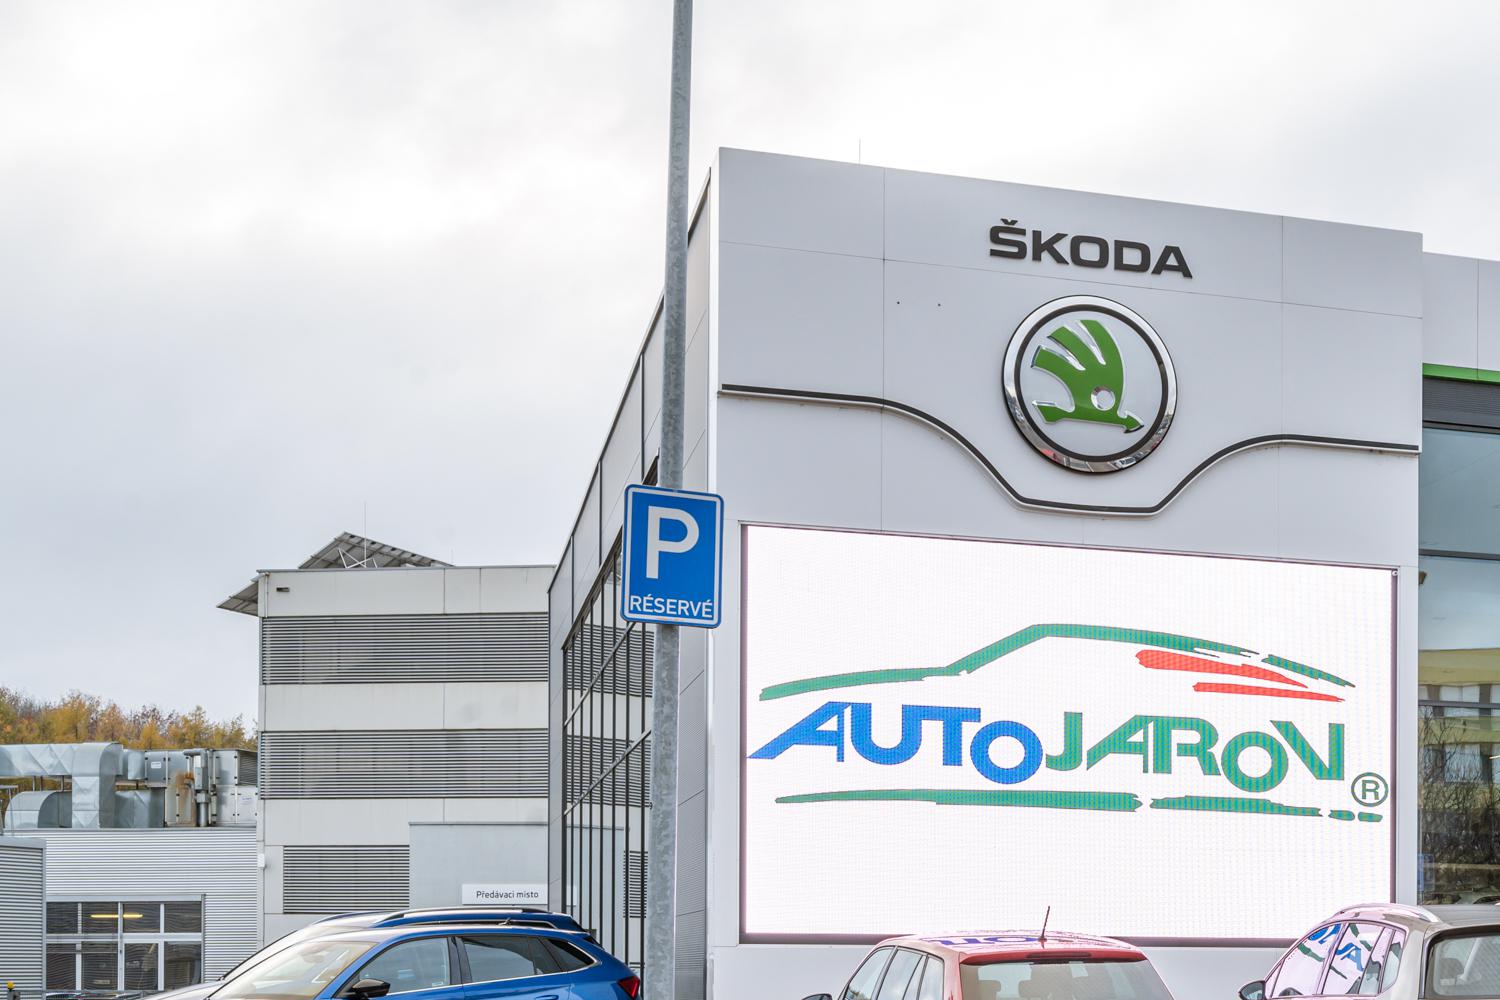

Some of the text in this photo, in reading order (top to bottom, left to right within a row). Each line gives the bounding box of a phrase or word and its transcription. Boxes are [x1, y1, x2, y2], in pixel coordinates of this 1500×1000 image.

[990, 218, 1193, 279] ŠKODA
[646, 505, 699, 579] P
[630, 594, 713, 618] RÉSERVÉ
